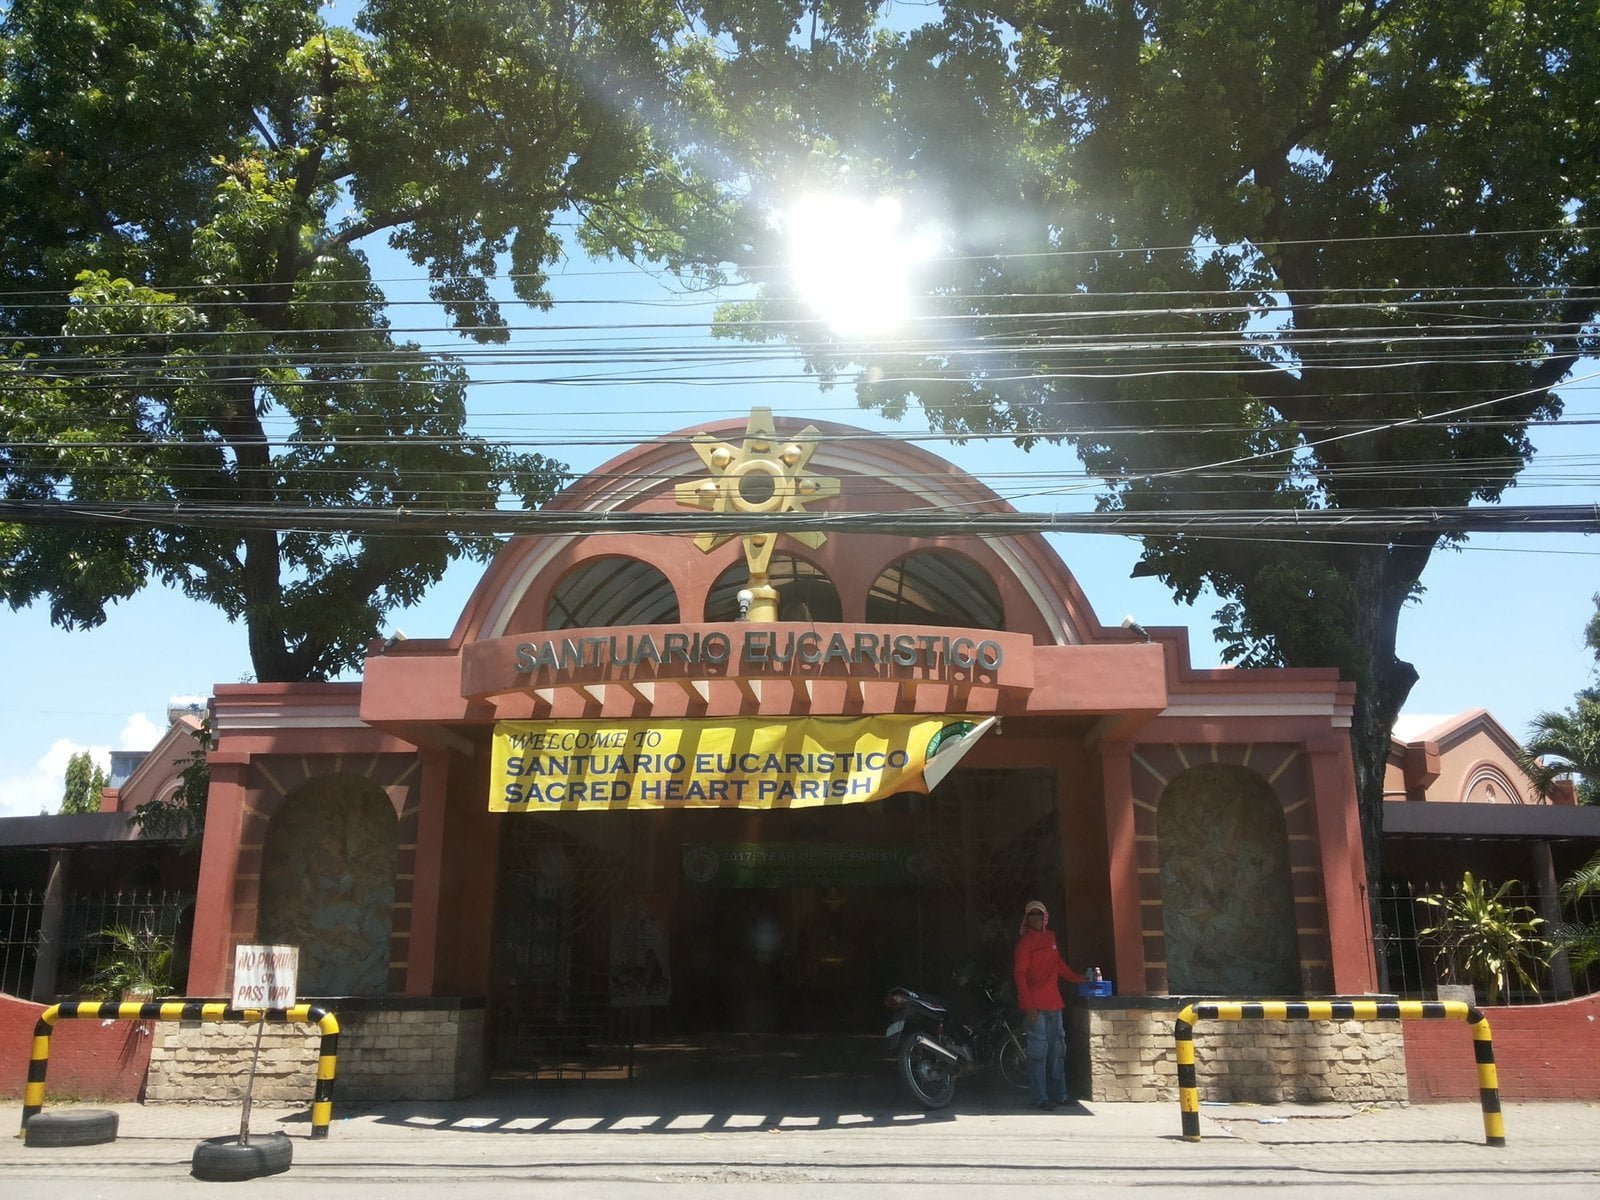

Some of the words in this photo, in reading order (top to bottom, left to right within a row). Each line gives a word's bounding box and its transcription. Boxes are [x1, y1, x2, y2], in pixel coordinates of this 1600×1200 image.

[515, 631, 732, 673] SANTUARIO
[743, 631, 1004, 671] EUCARISTICO
[509, 731, 626, 750] WELCOME
[633, 729, 662, 748] TO
[506, 754, 687, 776] SANTUARIO
[695, 750, 909, 774] EUCARISTICO
[504, 780, 632, 803] SACRED
[641, 779, 750, 801] HEART
[758, 777, 871, 800] PARISH
[238, 952, 255, 970] NO
[238, 985, 264, 1001] PASS
[268, 985, 290, 1002] WAY
